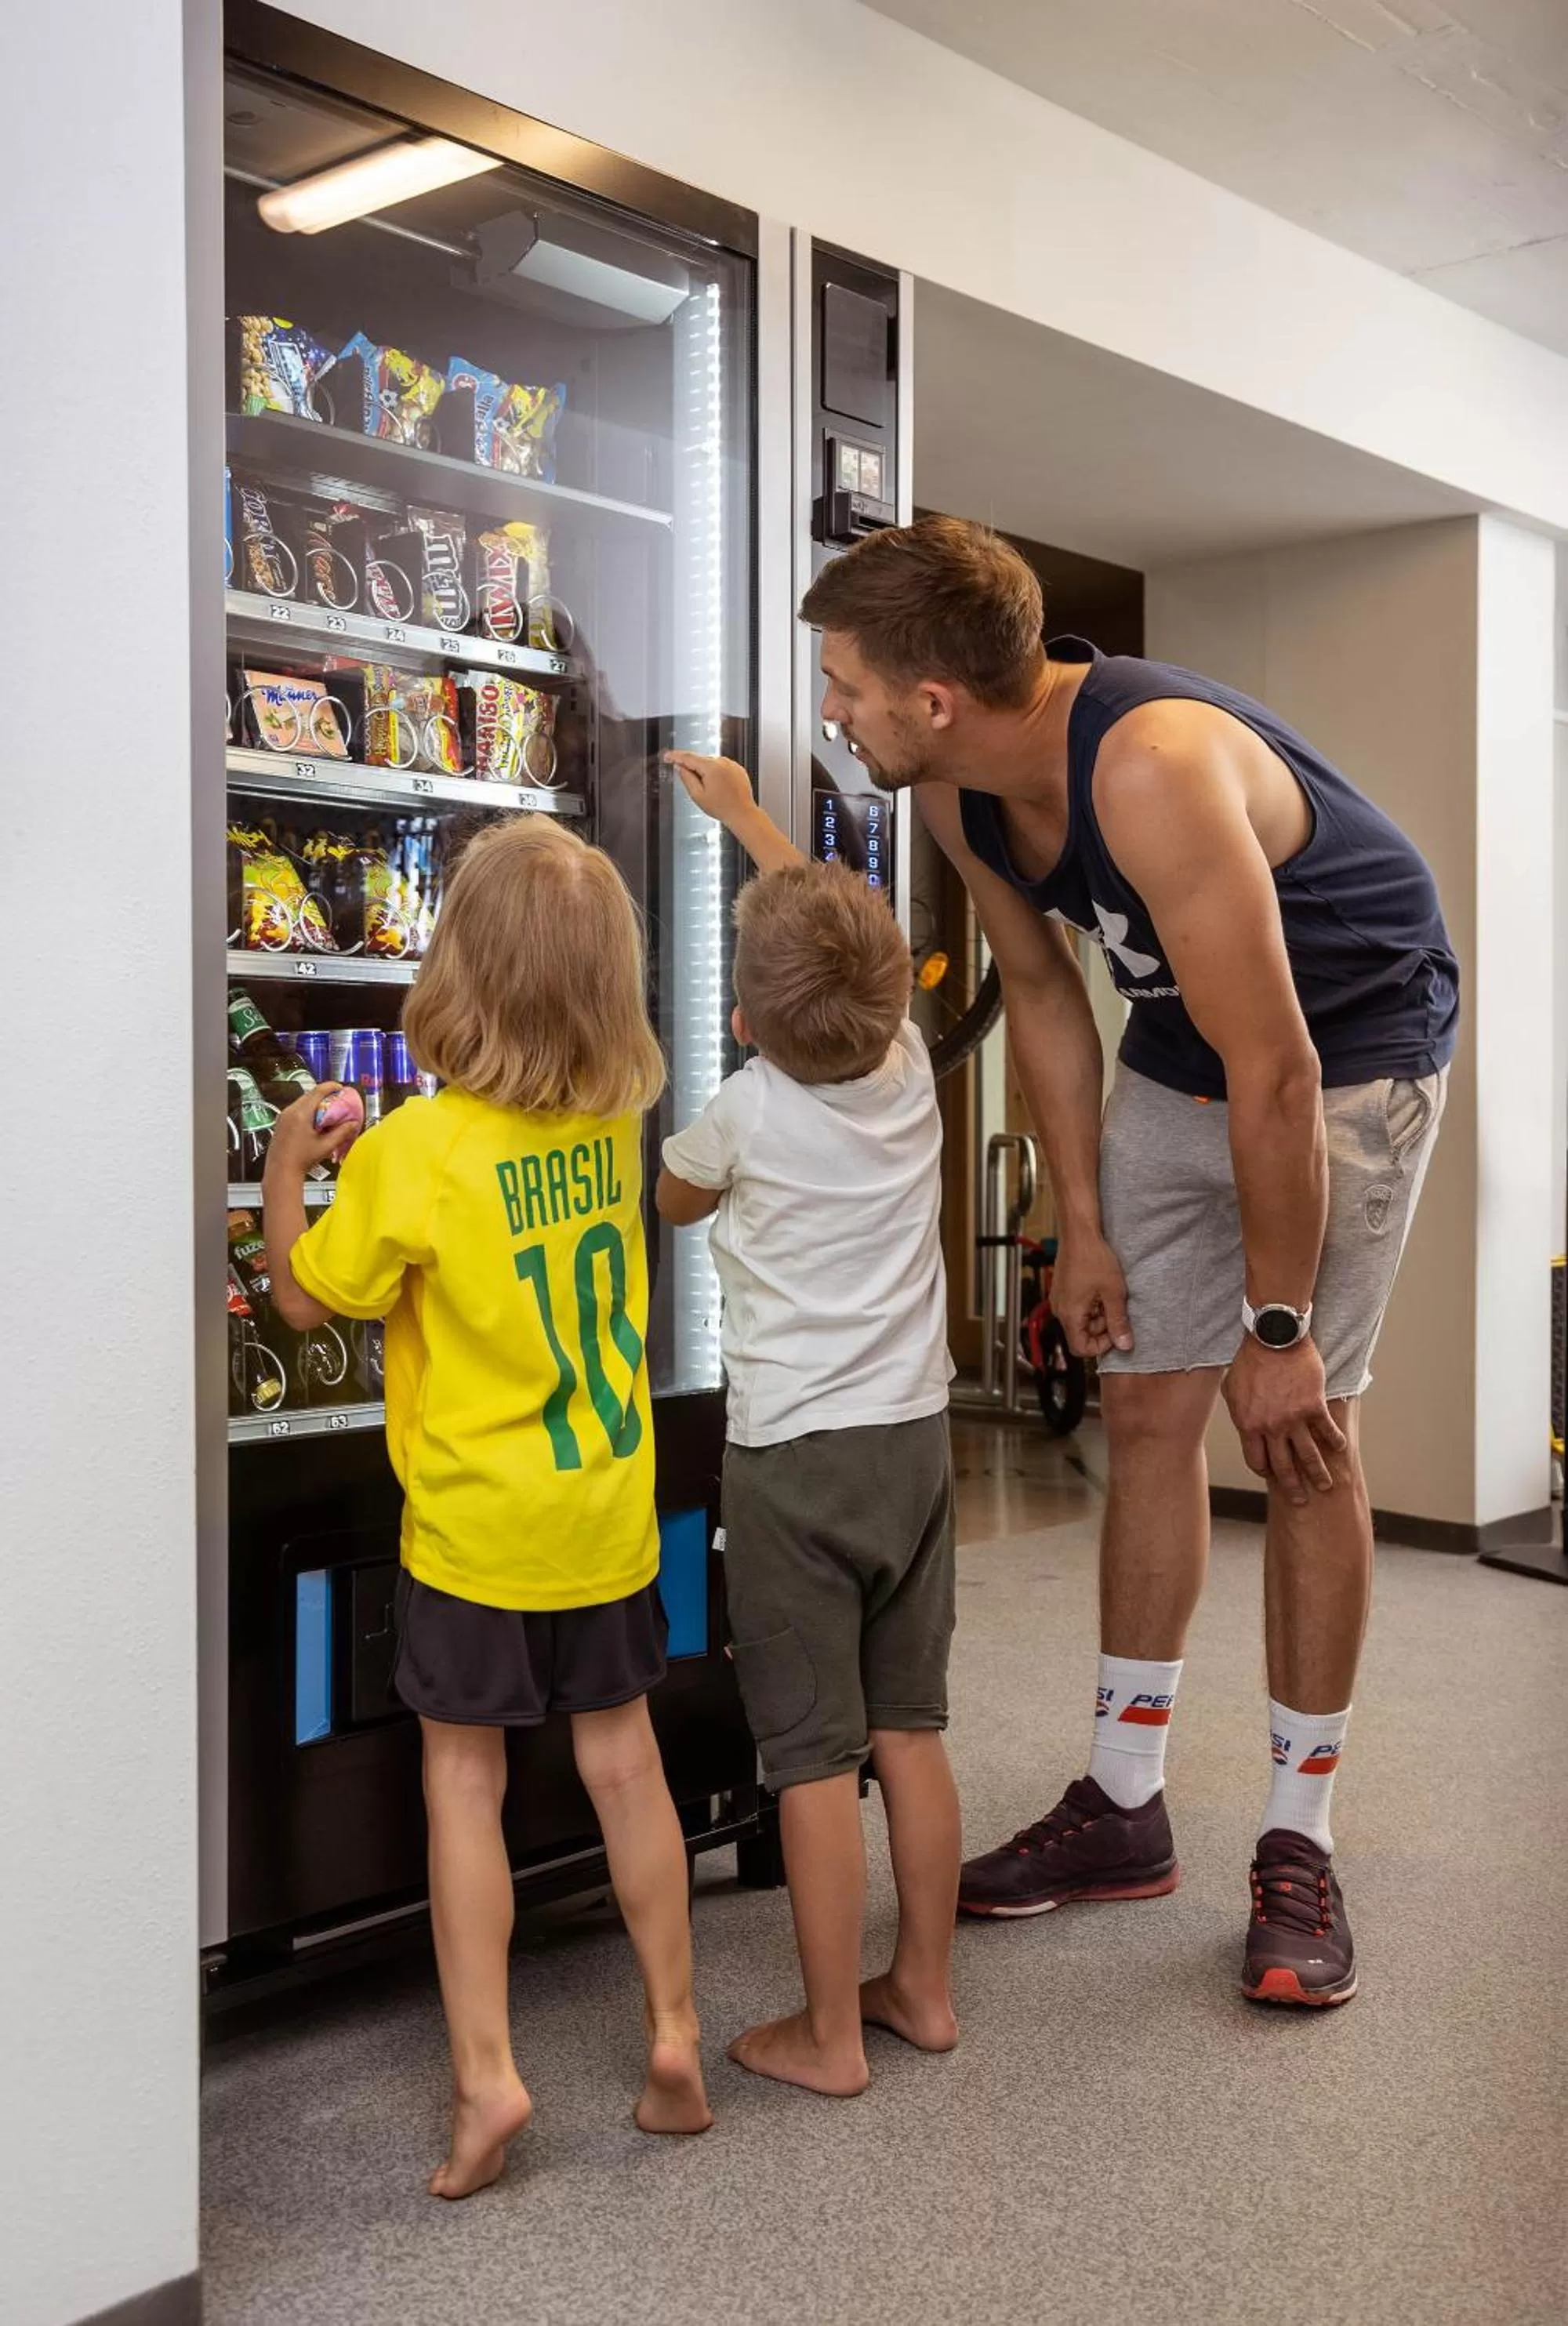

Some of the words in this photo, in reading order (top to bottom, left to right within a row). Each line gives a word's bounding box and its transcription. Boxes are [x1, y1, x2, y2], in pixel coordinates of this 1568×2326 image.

[271, 605, 290, 620] 22
[388, 628, 405, 641] 24
[443, 639, 459, 652] 25
[552, 659, 566, 673] 27
[296, 764, 314, 776] 32
[416, 779, 433, 792] 34
[826, 800, 833, 810] 1
[869, 806, 879, 817] 6
[826, 817, 835, 829] 2
[869, 823, 878, 833] 7
[825, 834, 835, 846] 3
[869, 840, 879, 851] 8
[869, 858, 878, 868] 9
[298, 962, 315, 974] 42
[1119, 985, 1180, 998] ARMO
[495, 1136, 622, 1236] BRASIL
[234, 1240, 266, 1260] fuze
[514, 1221, 644, 1471] 10
[272, 1421, 289, 1435] 62
[332, 1416, 347, 1428] 63
